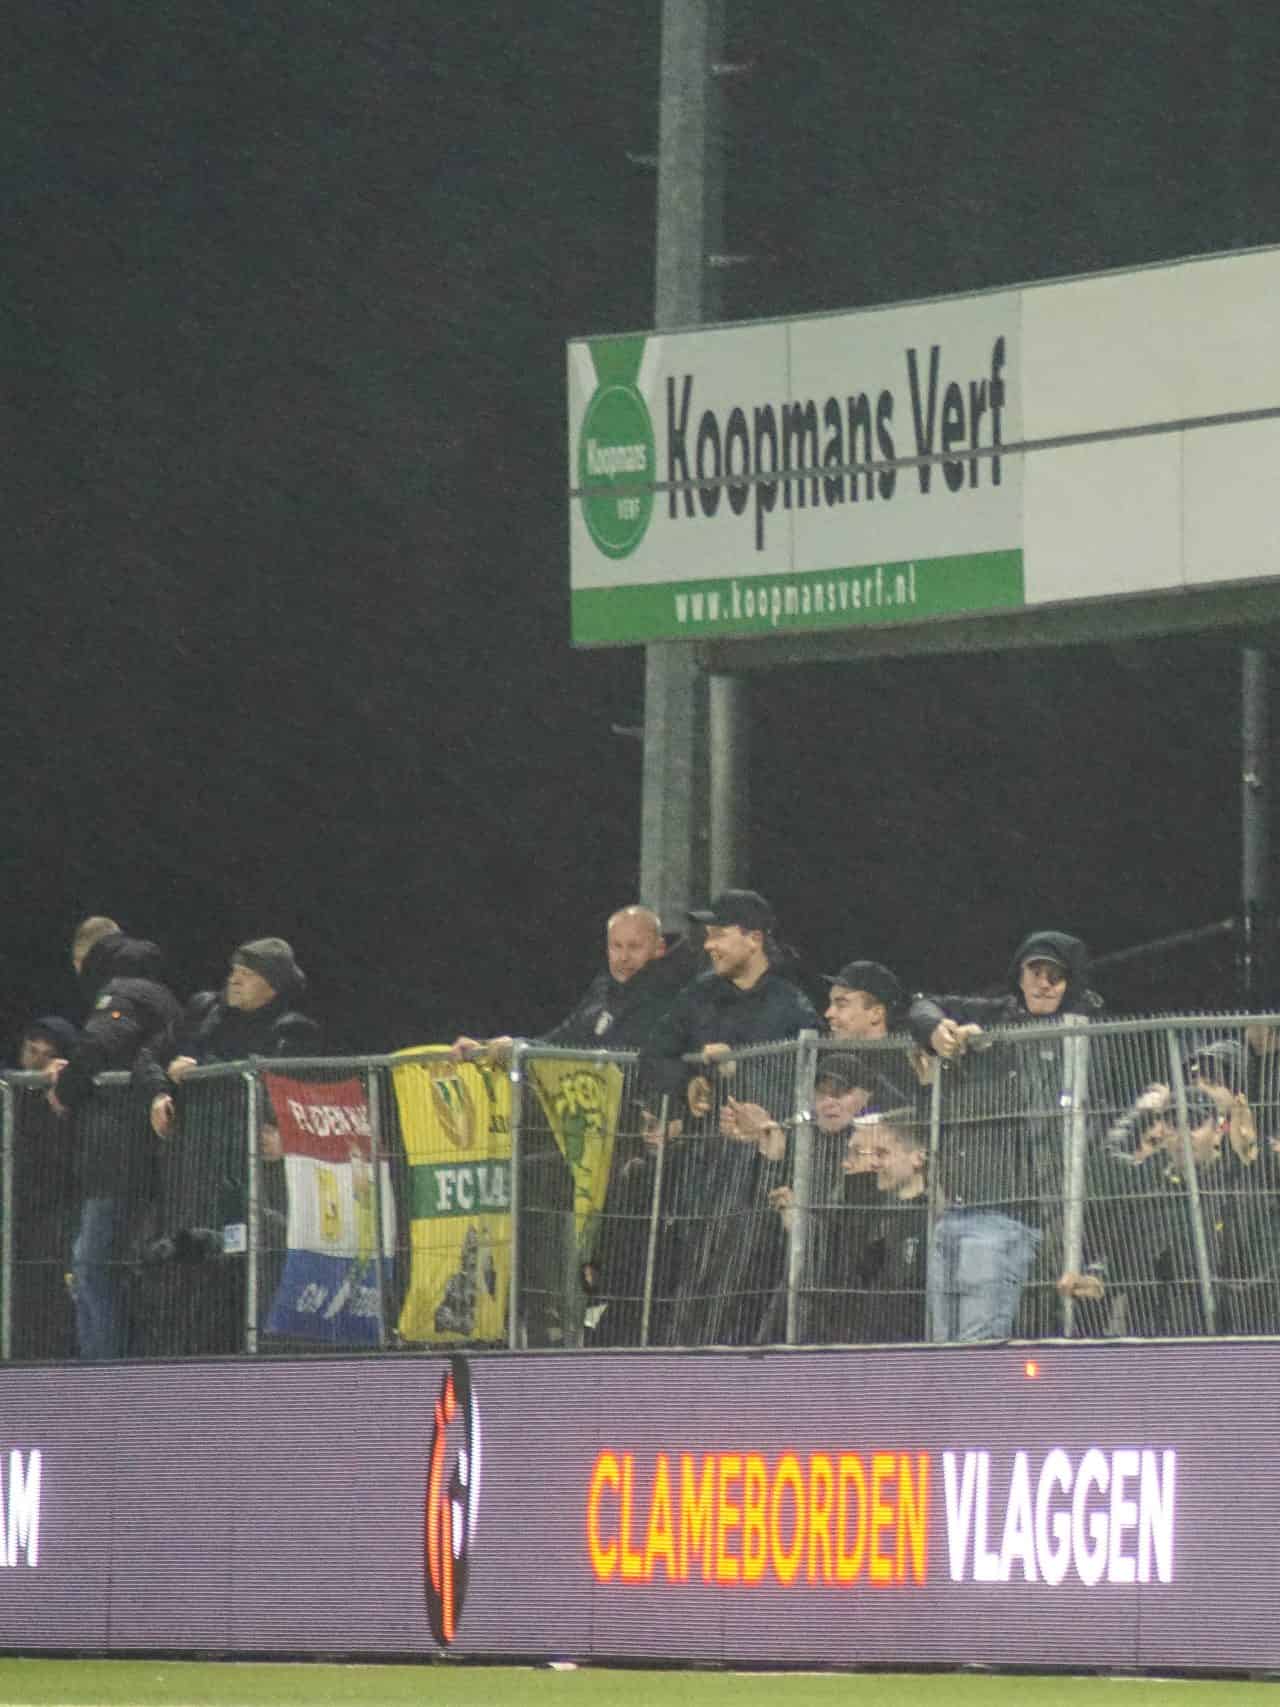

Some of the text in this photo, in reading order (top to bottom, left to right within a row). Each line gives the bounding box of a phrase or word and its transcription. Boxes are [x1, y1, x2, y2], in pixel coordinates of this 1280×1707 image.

[666, 336, 1005, 551] Koopmans Verf
[674, 563, 917, 627] www.koopmansverf.nl
[586, 1447, 1176, 1586] CLAMEBORDEN VLAGGEN
